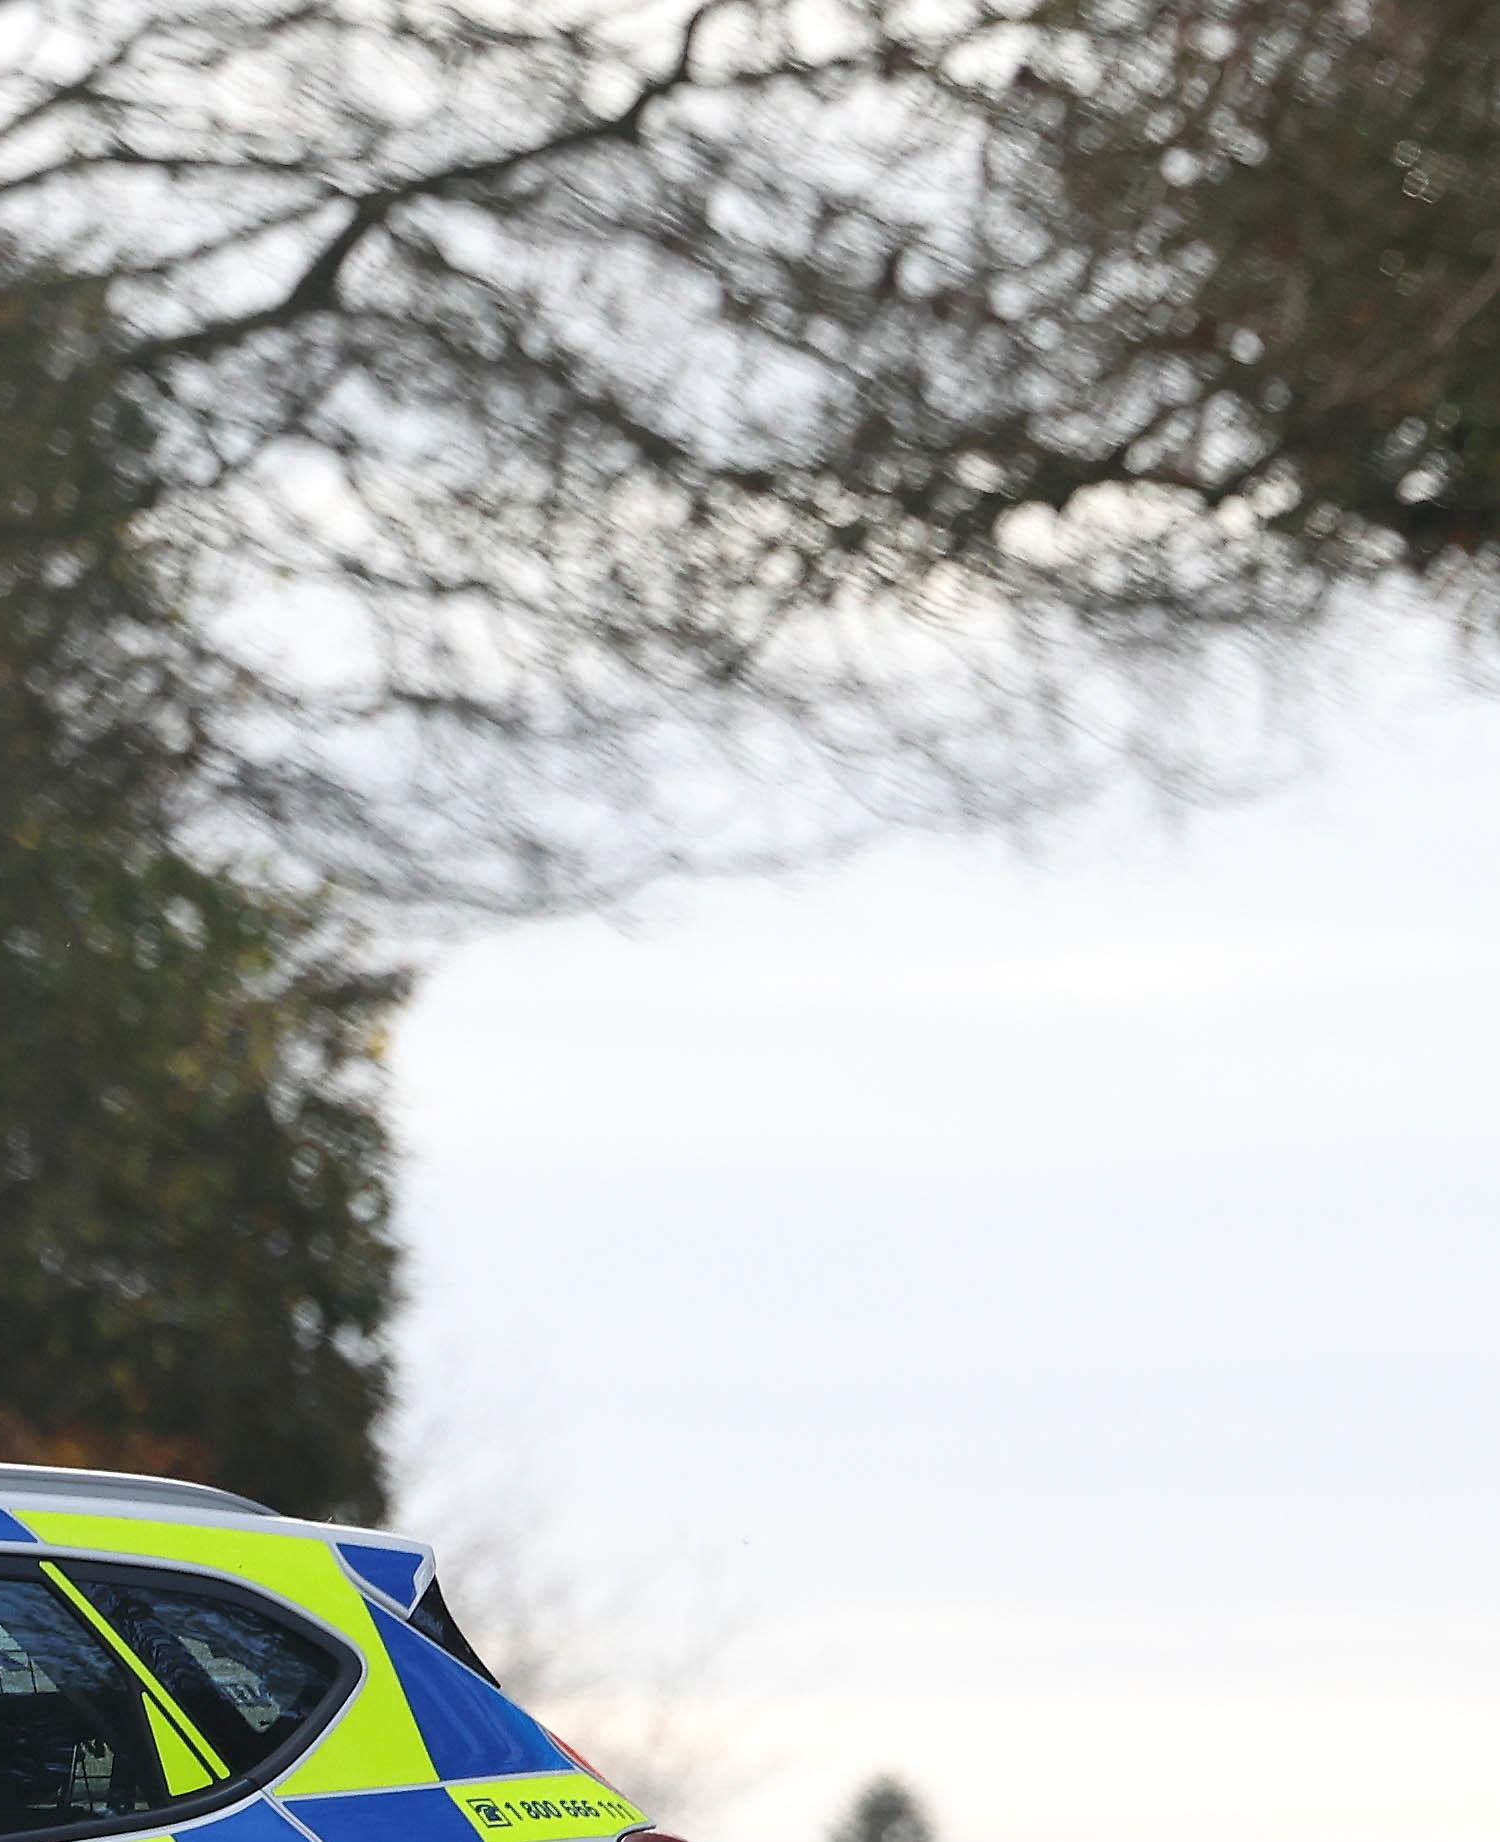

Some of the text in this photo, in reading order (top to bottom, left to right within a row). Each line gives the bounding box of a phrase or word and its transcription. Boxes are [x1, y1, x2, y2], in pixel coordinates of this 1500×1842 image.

[503, 1801, 524, 1821] 1
[523, 1800, 562, 1820] 800
[598, 1801, 635, 1821] 111
